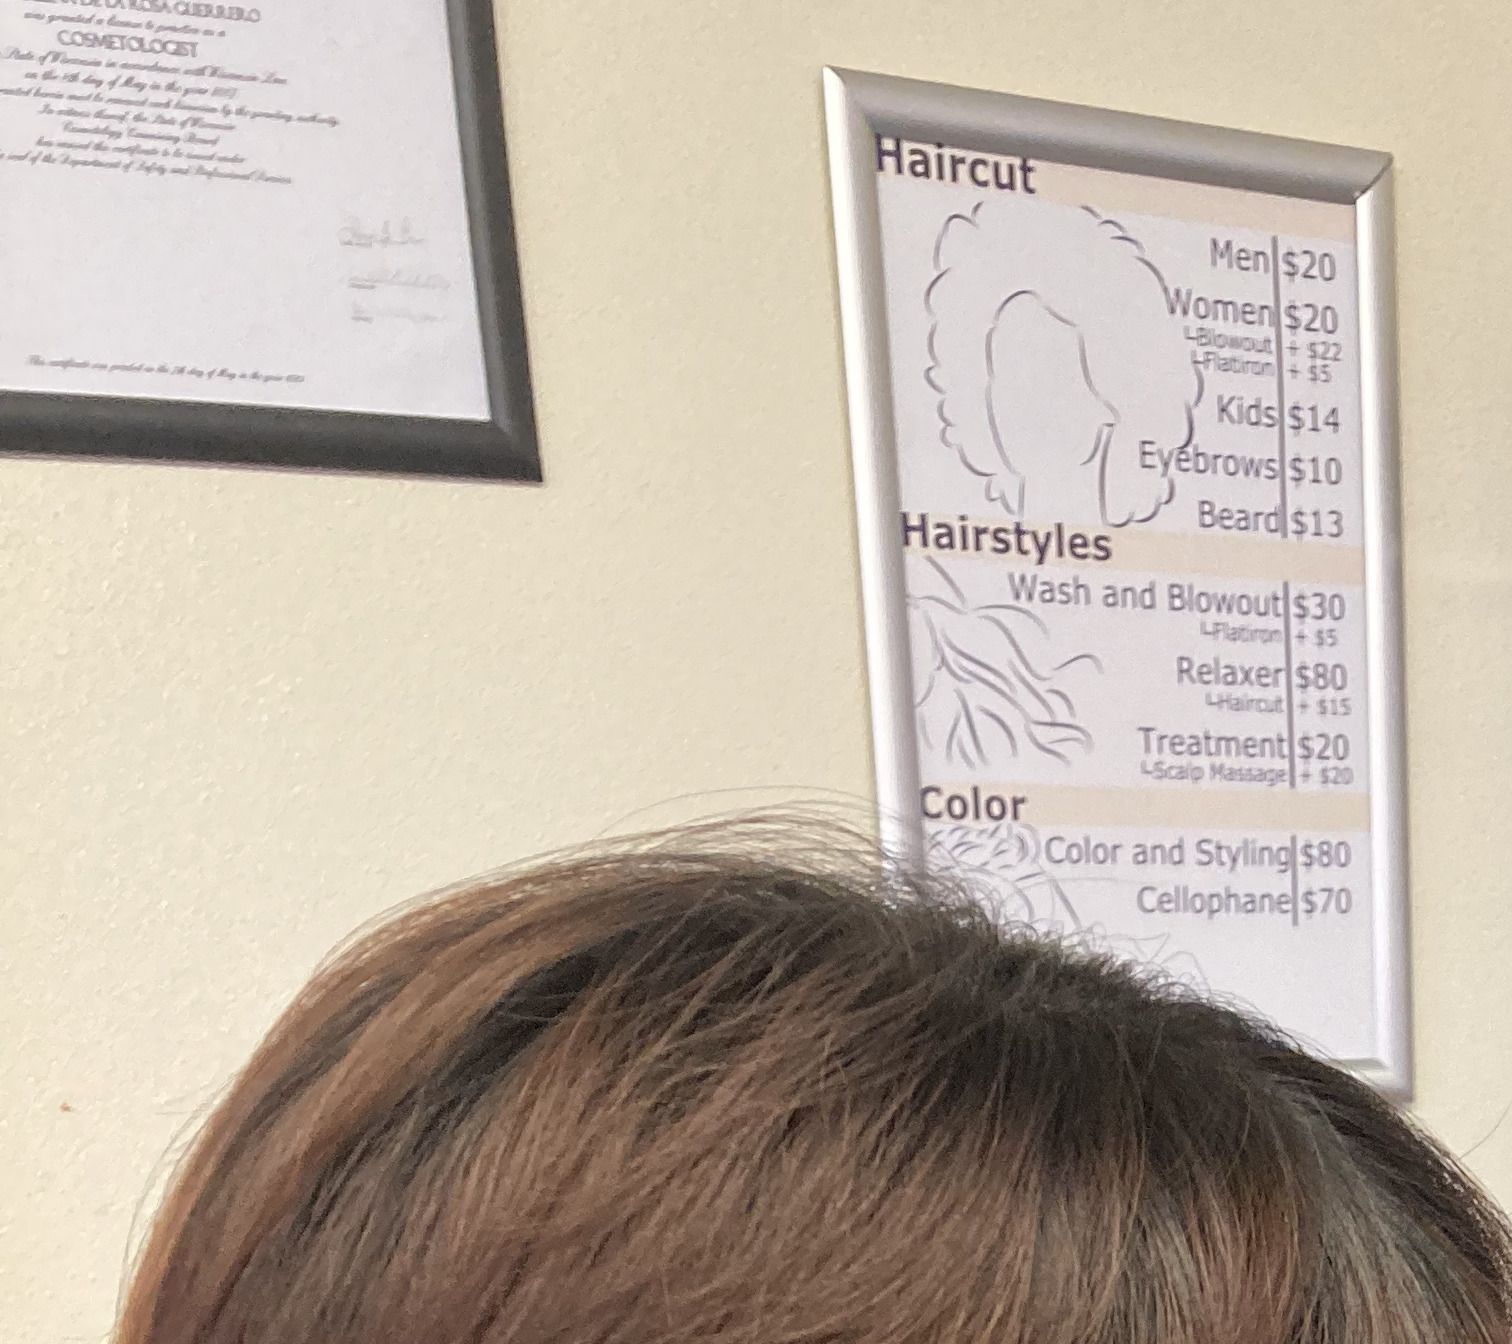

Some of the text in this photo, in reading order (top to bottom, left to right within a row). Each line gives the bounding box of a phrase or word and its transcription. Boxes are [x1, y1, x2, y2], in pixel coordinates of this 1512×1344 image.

[874, 133, 1036, 195] Haircut
[1210, 238, 1337, 283] Men $20
[1166, 286, 1339, 337] Women $20
[1307, 363, 1332, 384] $5
[1216, 395, 1341, 436] Kids $14
[1138, 440, 1342, 488] Eyebrows $10
[901, 511, 1113, 566] Hairstyles
[1199, 499, 1344, 541] Beard $13
[1007, 571, 1346, 624] Wash and Blowout $30
[1315, 627, 1339, 648] $5
[1176, 656, 1348, 694] Relaxer $80
[1137, 726, 1350, 763] Treatment $20
[920, 784, 1027, 824] Color
[1044, 835, 1353, 875] Color and Styling $80
[1136, 885, 1353, 921] Cellophane $70
